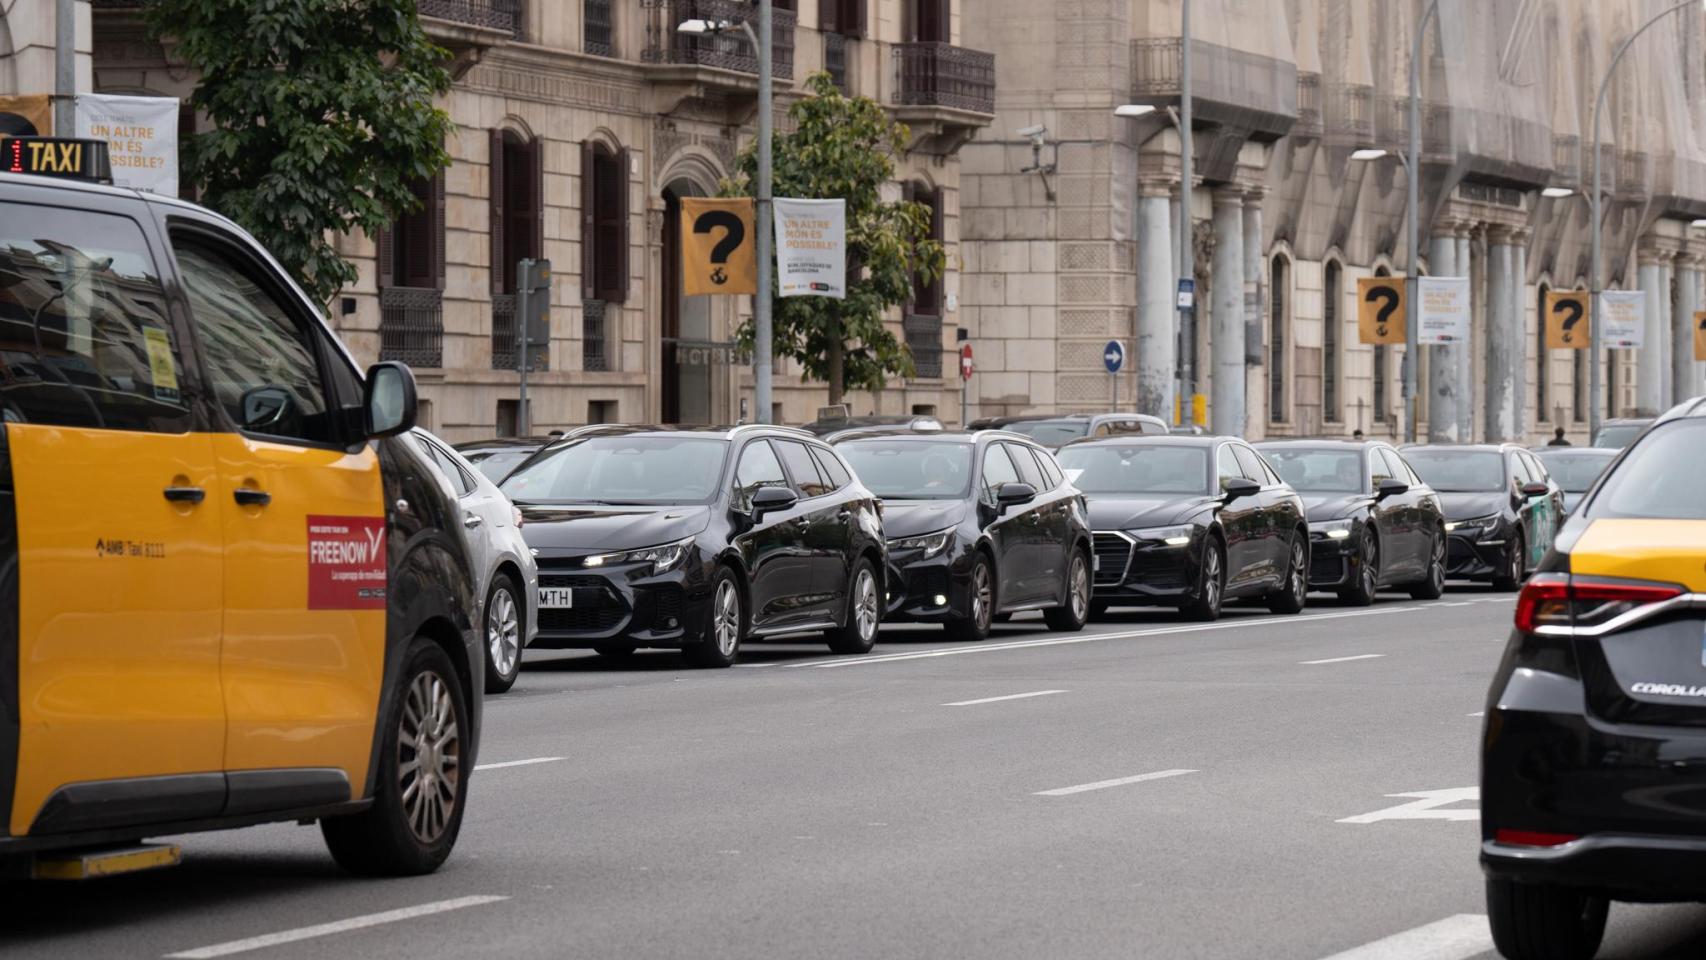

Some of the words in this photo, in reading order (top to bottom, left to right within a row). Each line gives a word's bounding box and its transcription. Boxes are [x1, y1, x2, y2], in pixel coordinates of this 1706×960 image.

[90, 124, 110, 137] UN
[114, 126, 155, 139] ALTRE
[28, 142, 82, 172] TAXI
[112, 154, 164, 168] SSIBLE?
[539, 590, 568, 606] MTH
